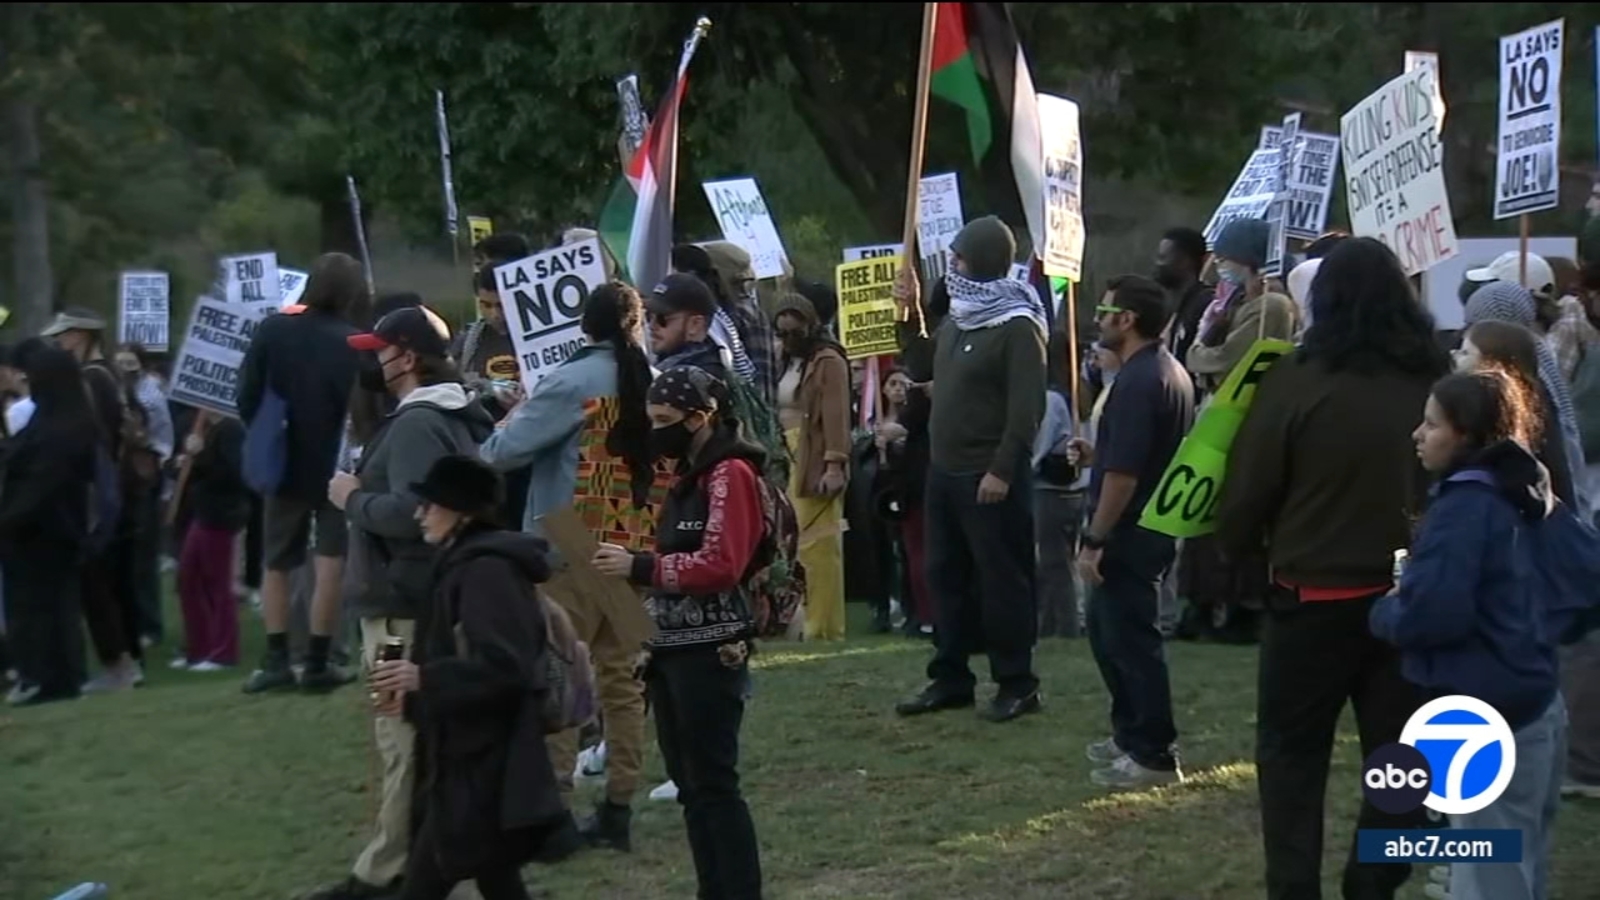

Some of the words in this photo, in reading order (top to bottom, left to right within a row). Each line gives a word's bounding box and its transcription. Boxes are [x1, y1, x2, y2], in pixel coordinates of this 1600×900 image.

[1506, 41, 1522, 64] LA
[1525, 29, 1560, 58] SAYS
[1508, 56, 1549, 111] NO
[1344, 95, 1391, 162] KILLING
[1392, 72, 1432, 136] KIDS
[1299, 165, 1330, 187] THE
[1502, 153, 1537, 198] JOE!
[1288, 202, 1319, 230] W!
[1399, 191, 1409, 214] A
[1395, 205, 1452, 272] CRIME
[236, 259, 264, 281] END
[502, 266, 530, 290] LA
[535, 246, 594, 279] SAYS
[842, 265, 870, 289] FREE
[241, 281, 266, 302] ALL
[513, 274, 589, 333] NO
[197, 305, 239, 333] FREE
[182, 354, 240, 386] POLITIC
[522, 353, 540, 371] TO
